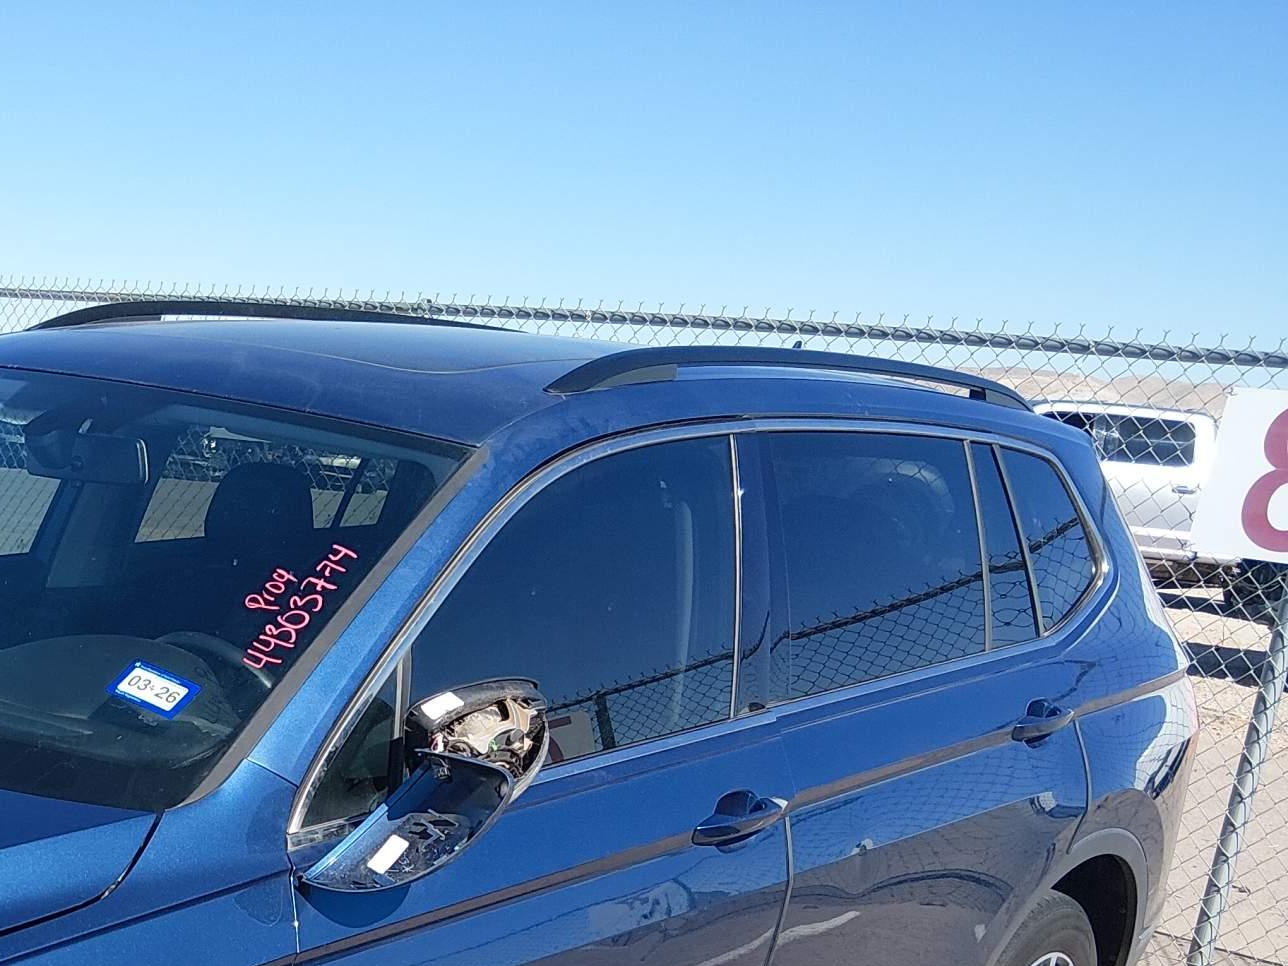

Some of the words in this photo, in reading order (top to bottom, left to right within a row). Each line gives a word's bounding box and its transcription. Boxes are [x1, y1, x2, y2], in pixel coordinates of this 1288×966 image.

[243, 544, 358, 669] 44303774
[127, 675, 152, 691] 03
[154, 686, 181, 704] 26
